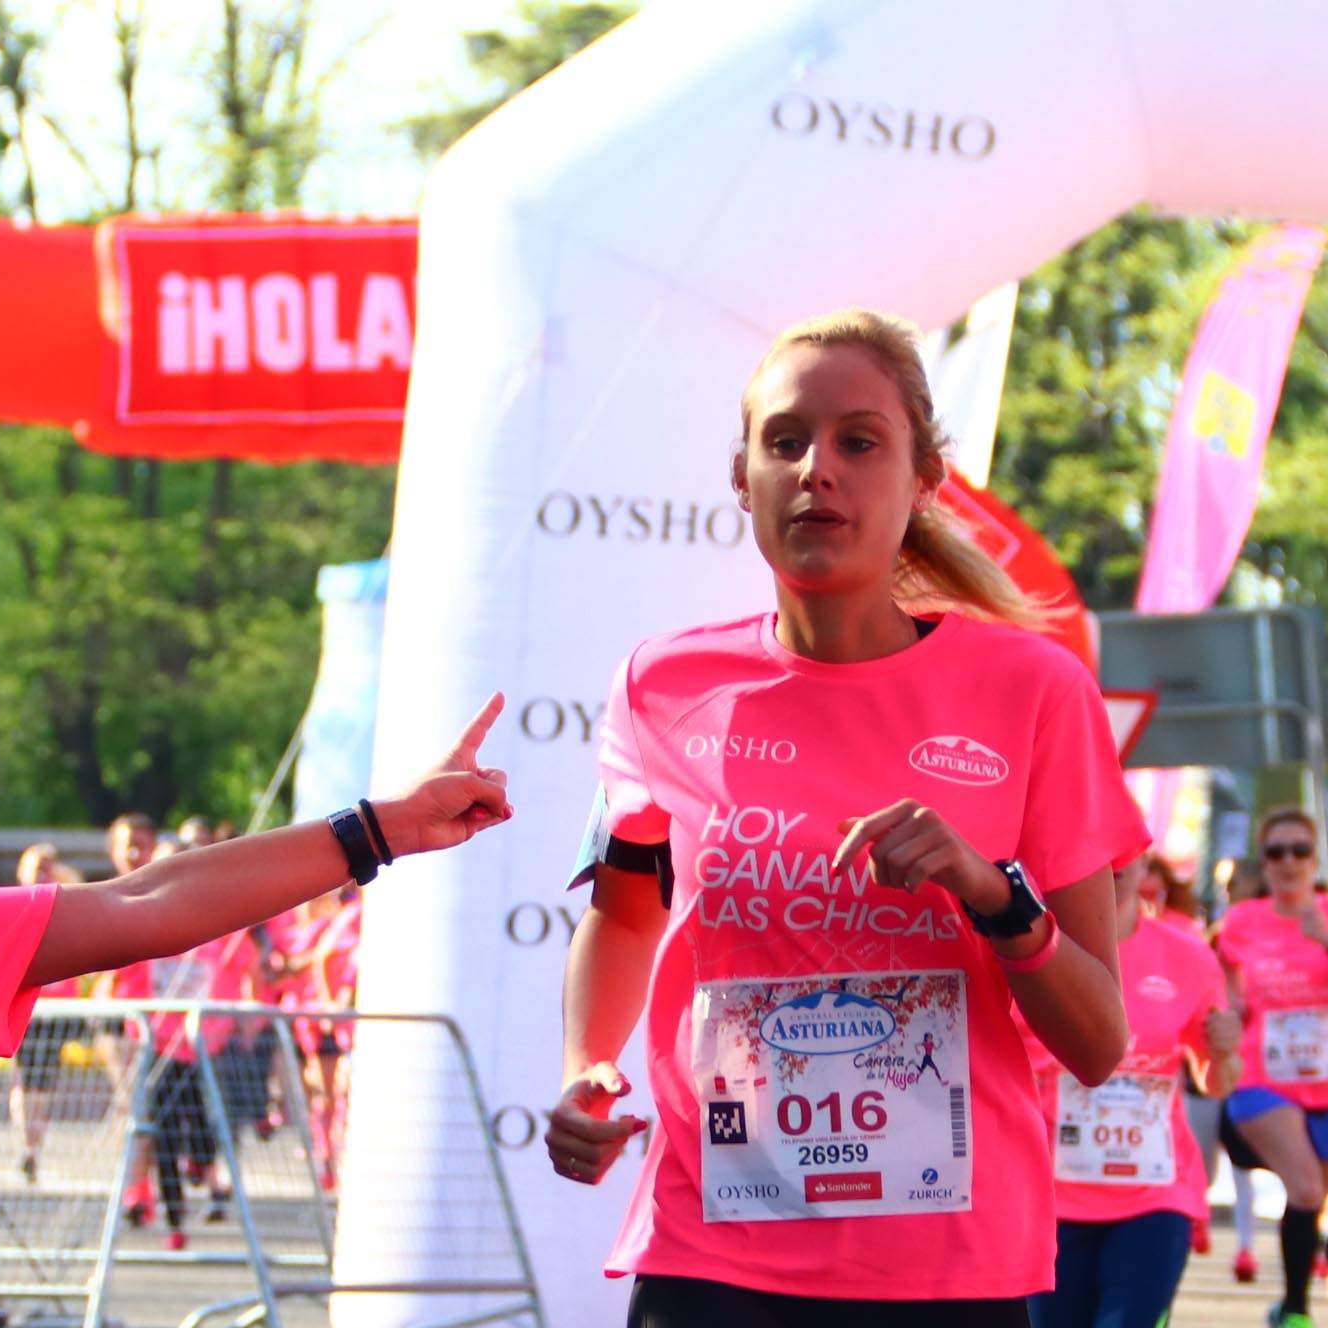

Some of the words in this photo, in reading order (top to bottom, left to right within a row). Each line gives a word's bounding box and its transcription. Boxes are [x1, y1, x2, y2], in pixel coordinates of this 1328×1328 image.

[772, 92, 997, 161] OYSHO
[158, 272, 415, 374] ¡HOLA
[536, 492, 746, 550] OYSHO
[685, 735, 798, 763] OYSHO
[916, 747, 1000, 778] ASTURIANA
[700, 804, 807, 846] HOY
[699, 895, 769, 932] LAS
[783, 896, 961, 943] CHICAS
[771, 1017, 886, 1041] ASTURIANA
[853, 1054, 904, 1069] Carrera
[885, 1068, 920, 1090] Mujer
[777, 1090, 887, 1136] 016
[1094, 1125, 1142, 1146] 016
[798, 1143, 868, 1166] 26959
[718, 1184, 780, 1199] OYSHO
[827, 1182, 872, 1192] Santander
[908, 1189, 952, 1200] ZURICH
